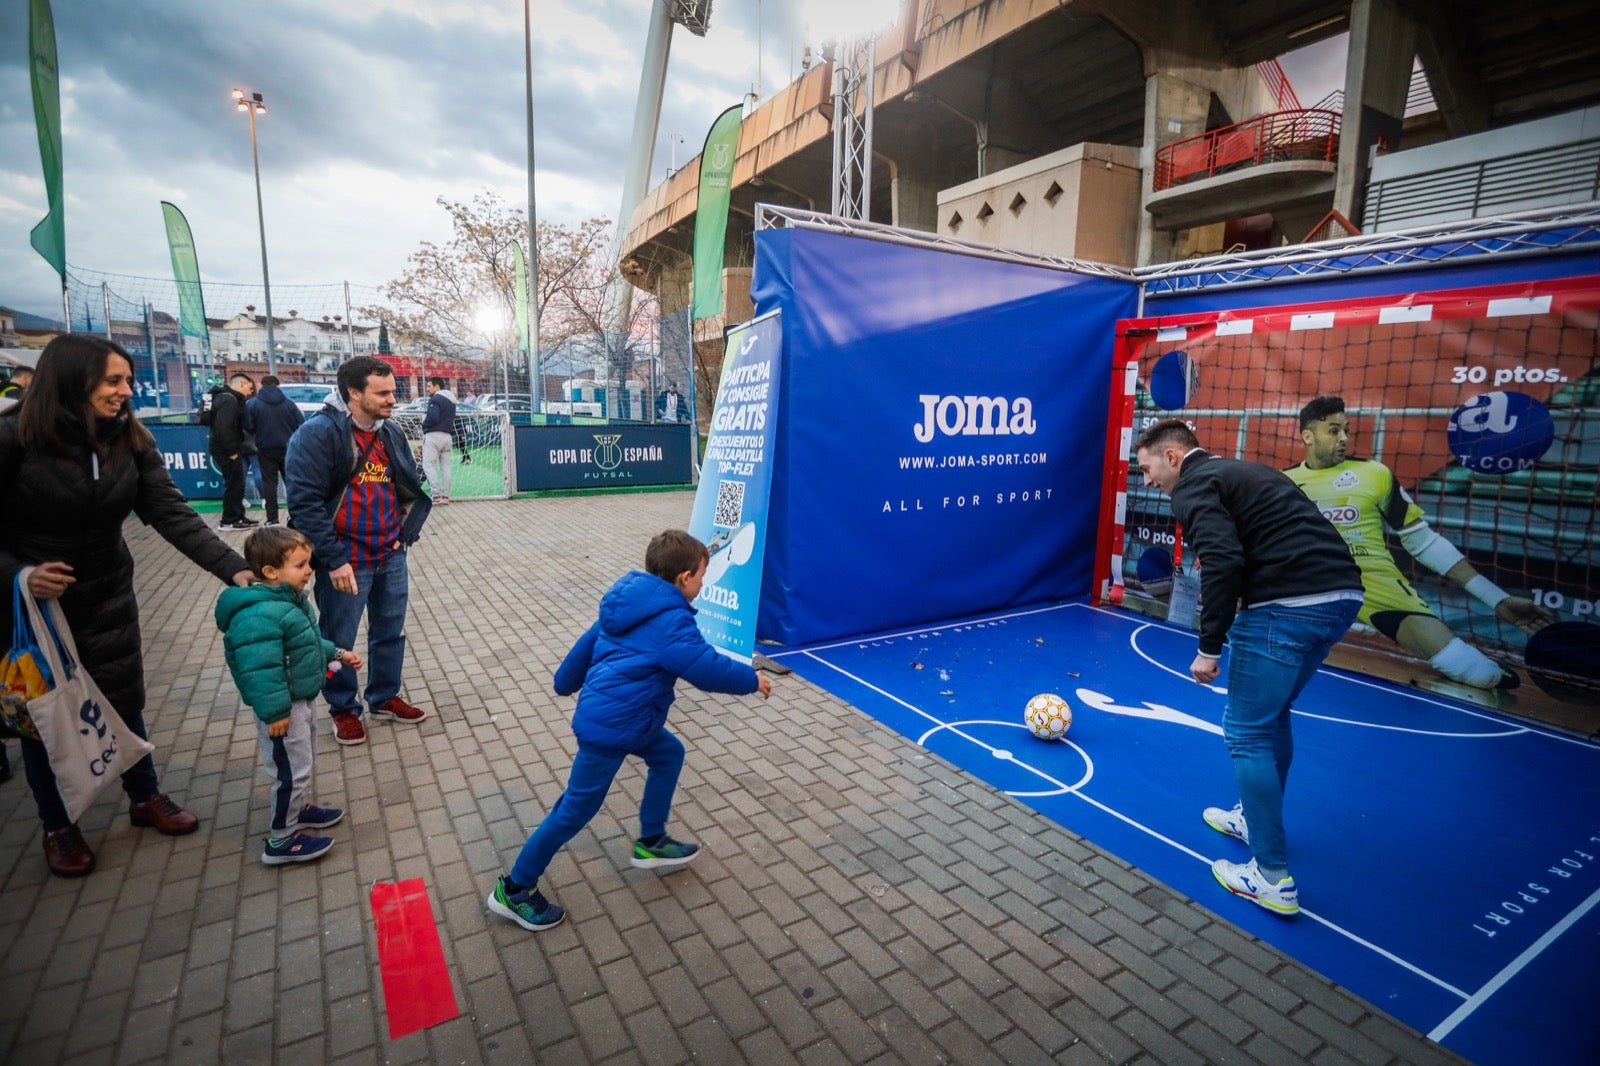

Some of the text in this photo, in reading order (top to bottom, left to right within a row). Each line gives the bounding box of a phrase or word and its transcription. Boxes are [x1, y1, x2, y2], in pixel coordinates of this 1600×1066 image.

[722, 360, 771, 387] PARTICIPA
[1451, 366, 1568, 387] 30 ptos.
[720, 383, 770, 404] Y CONSIGUE
[714, 402, 768, 431] GRATIS
[709, 435, 758, 448] DESCUENTOS
[160, 452, 208, 470] PA DE
[549, 444, 663, 464] COPA DE ESPAÑA
[707, 448, 764, 462] UNA ZAPATILLA
[899, 453, 1048, 469] WWW.JOMA-SPORT.COM
[718, 461, 756, 477] TOP-FLEX
[882, 488, 1053, 513] ALL FOR SPORT
[1137, 526, 1151, 540] 10
[1531, 588, 1564, 609] 10
[1472, 882, 1551, 938] SPORT
